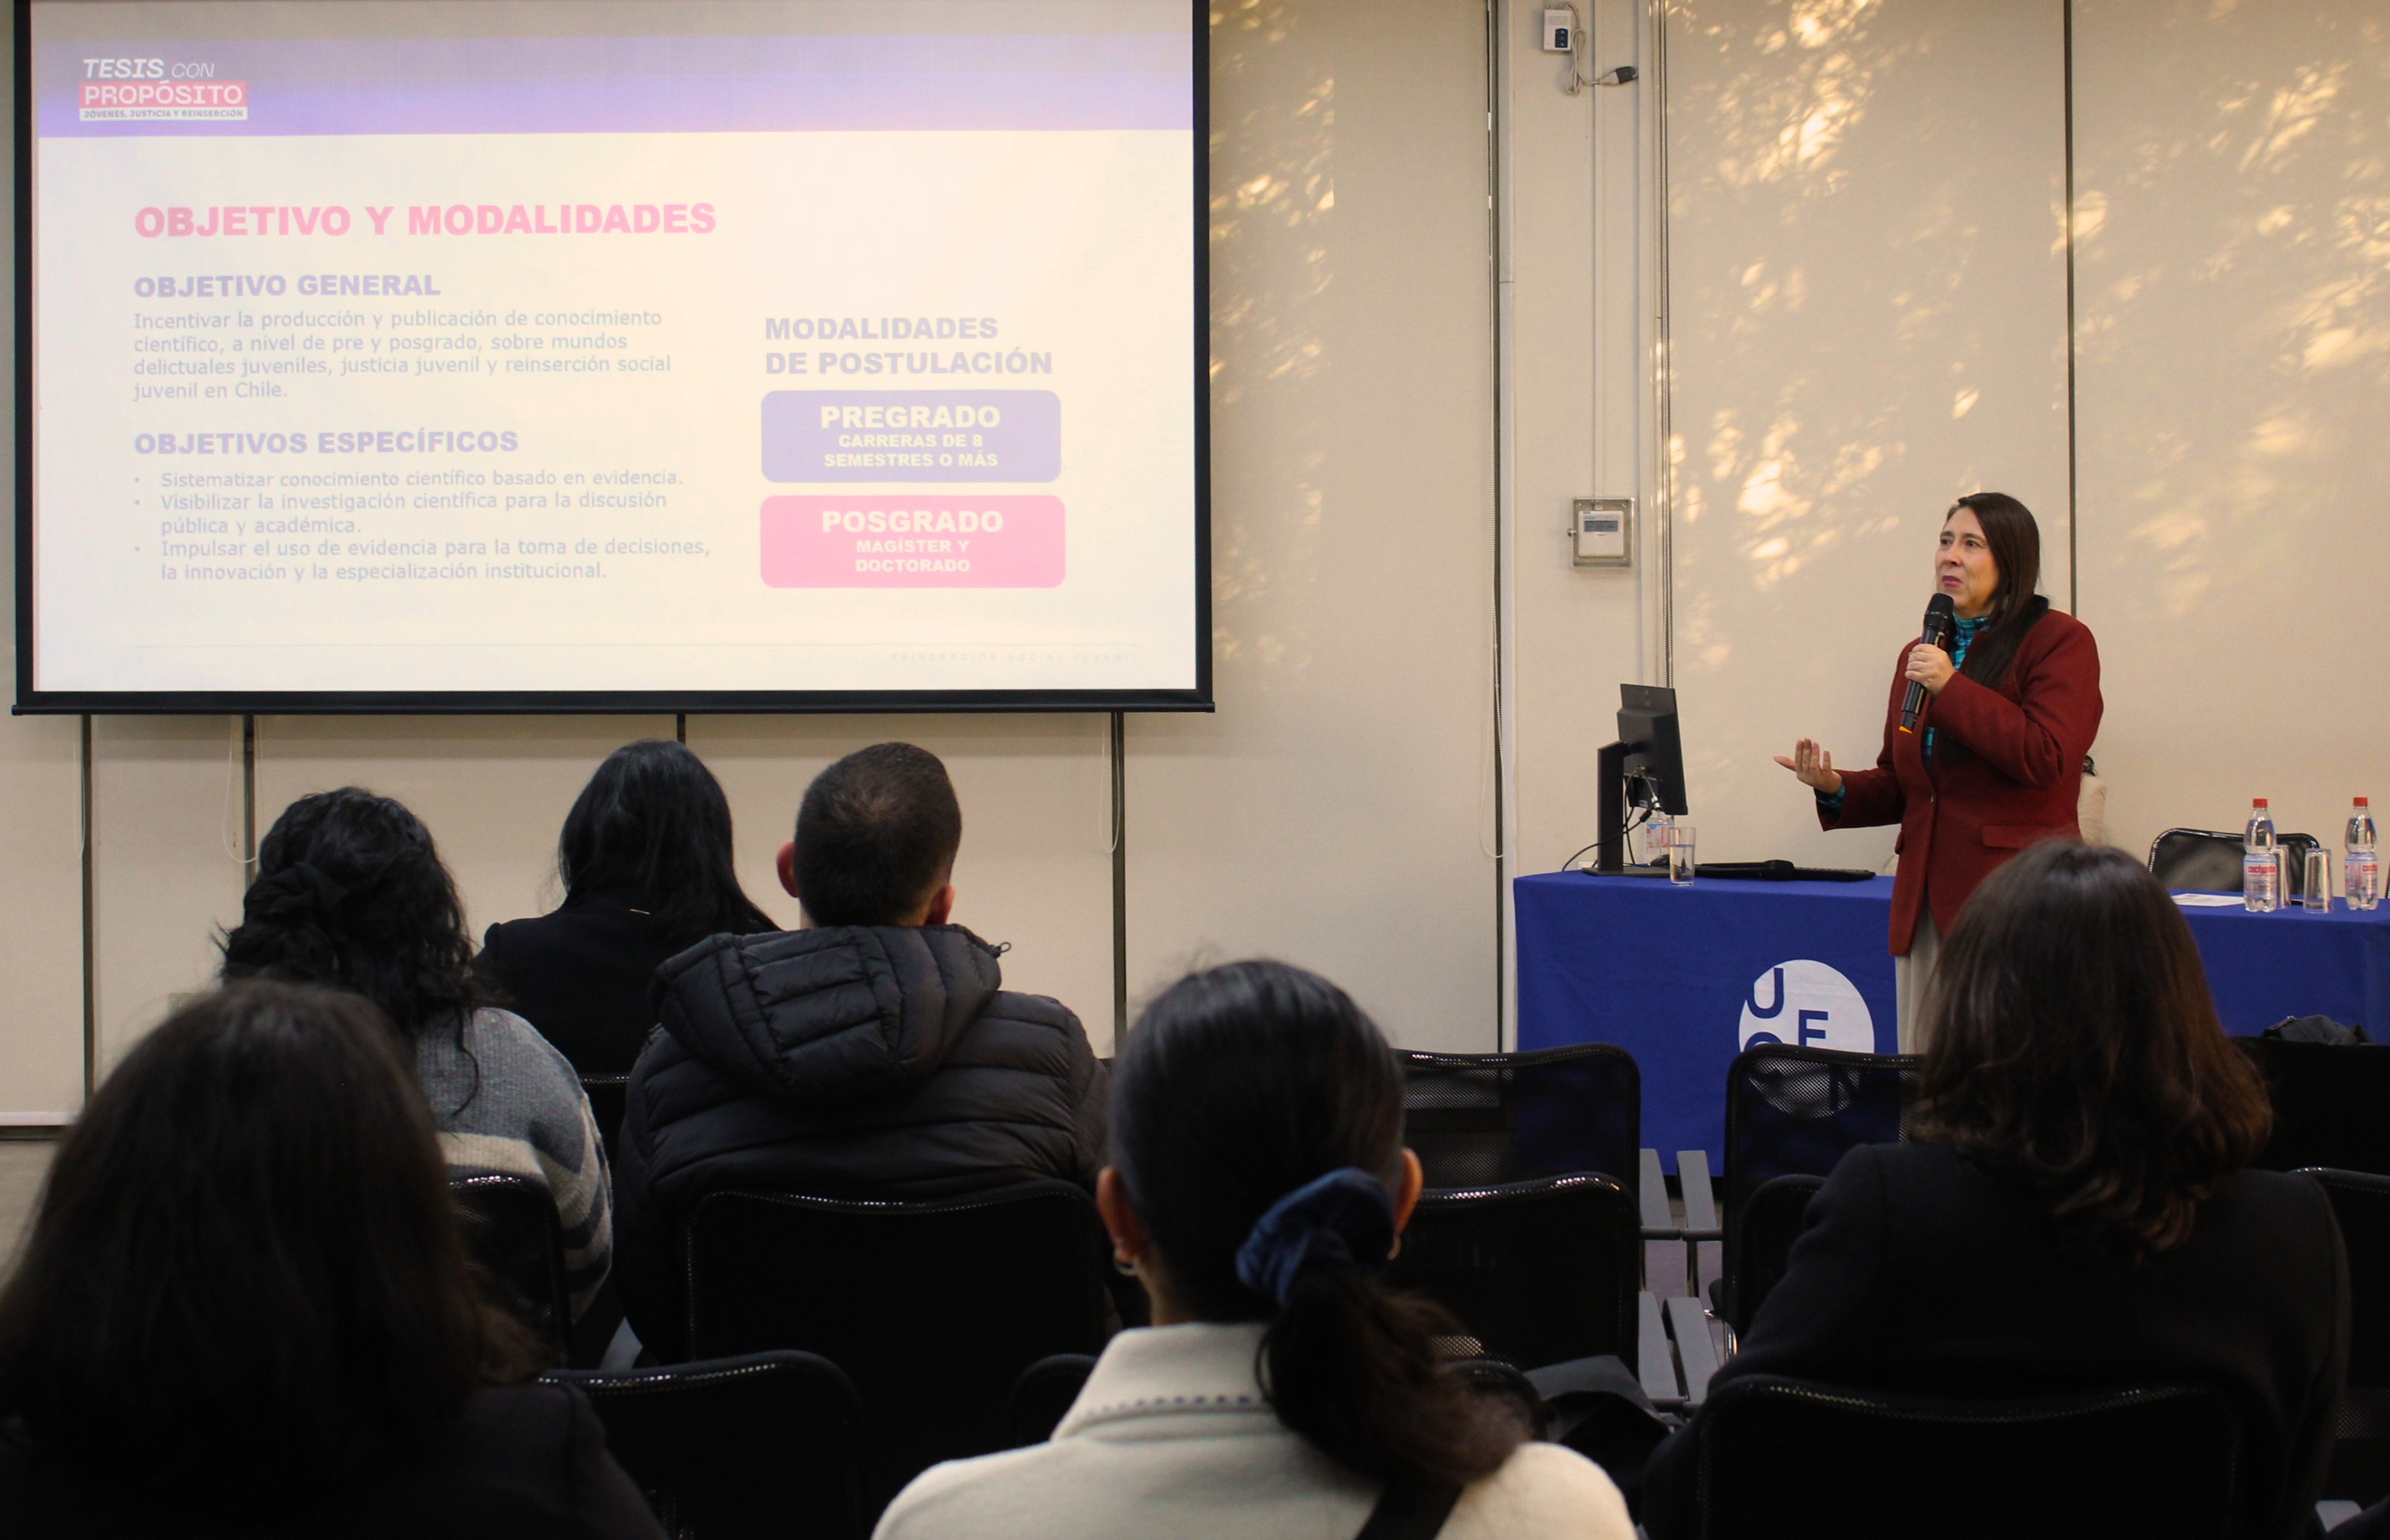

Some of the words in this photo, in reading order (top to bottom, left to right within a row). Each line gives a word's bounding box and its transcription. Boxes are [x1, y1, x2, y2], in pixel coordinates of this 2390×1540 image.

[83, 58, 164, 78] TESIS
[172, 63, 214, 78] CON
[85, 80, 242, 105] PROPÓSITO
[135, 206, 351, 238] OBJETIVO
[365, 206, 394, 235] Y
[409, 203, 715, 235] MODALIDADES
[134, 275, 286, 297] OBJETIVO
[297, 275, 440, 295] GENERAL
[135, 312, 231, 328] Incentivar
[238, 311, 253, 327] la
[261, 310, 364, 331] producción
[372, 315, 383, 330] y
[391, 310, 497, 330] publicación
[505, 310, 527, 326] de
[535, 310, 661, 326] conocimiento
[766, 317, 998, 340] MODALIDADES
[134, 336, 224, 354] científico,
[232, 339, 242, 351] a
[251, 334, 295, 351] nivel
[303, 335, 325, 350] de
[333, 338, 363, 353] pre
[371, 338, 381, 353] y
[389, 333, 482, 353] posgrado,
[491, 333, 543, 349] sobre
[551, 333, 627, 349] mundos
[134, 358, 235, 375] delictuales
[241, 357, 332, 378] juveniles,
[340, 357, 408, 376] justicia
[414, 356, 479, 376] juvenil
[487, 360, 498, 376] y
[506, 356, 609, 372] reinserción
[617, 355, 670, 372] social
[766, 352, 807, 374] DE
[819, 346, 1052, 374] POSTULACIÓN
[133, 382, 197, 402] juvenil
[205, 386, 227, 398] en
[235, 381, 287, 398] Chile.
[821, 406, 1000, 428] PREGRADO
[134, 433, 307, 454] OBJETIVOS
[318, 427, 518, 453] ESPECÍFICOS
[838, 434, 937, 448] CARRERAS
[943, 434, 967, 447] DE
[972, 434, 983, 447] 8
[824, 453, 934, 467] SEMESTRES
[939, 453, 953, 467] O
[957, 449, 998, 466] MÁS
[161, 472, 274, 487] Sistematizar
[280, 472, 399, 487] conocimiento
[406, 469, 485, 485] científico
[493, 469, 556, 485] basado
[563, 473, 585, 485] en
[593, 469, 682, 485] evidencia.
[161, 493, 251, 510] Visibilizar
[259, 493, 273, 509] la
[281, 493, 405, 513] investigación
[413, 491, 497, 508] científica
[505, 495, 546, 511] para
[555, 491, 570, 508] la
[579, 491, 666, 508] discusión
[161, 516, 228, 537] pública
[236, 521, 246, 536] y
[254, 516, 361, 534] académica.
[823, 510, 1004, 533] POSGRADO
[161, 540, 247, 560] Impulsar
[254, 540, 270, 556] el
[277, 544, 310, 556] uso
[317, 539, 340, 555] de
[348, 539, 437, 555] evidencia
[445, 543, 486, 558] para
[495, 538, 510, 555] la
[518, 540, 566, 554] toma
[575, 538, 597, 554] de
[604, 538, 709, 557] decisiones,
[857, 536, 951, 553] MAGÍSTER
[958, 540, 970, 553] Y
[161, 564, 176, 580] la
[185, 564, 286, 580] innovación
[294, 567, 305, 583] y
[312, 563, 327, 579] la
[336, 562, 477, 582] especialización
[485, 562, 606, 579] institucional.
[855, 559, 970, 572] DOCTORADO
